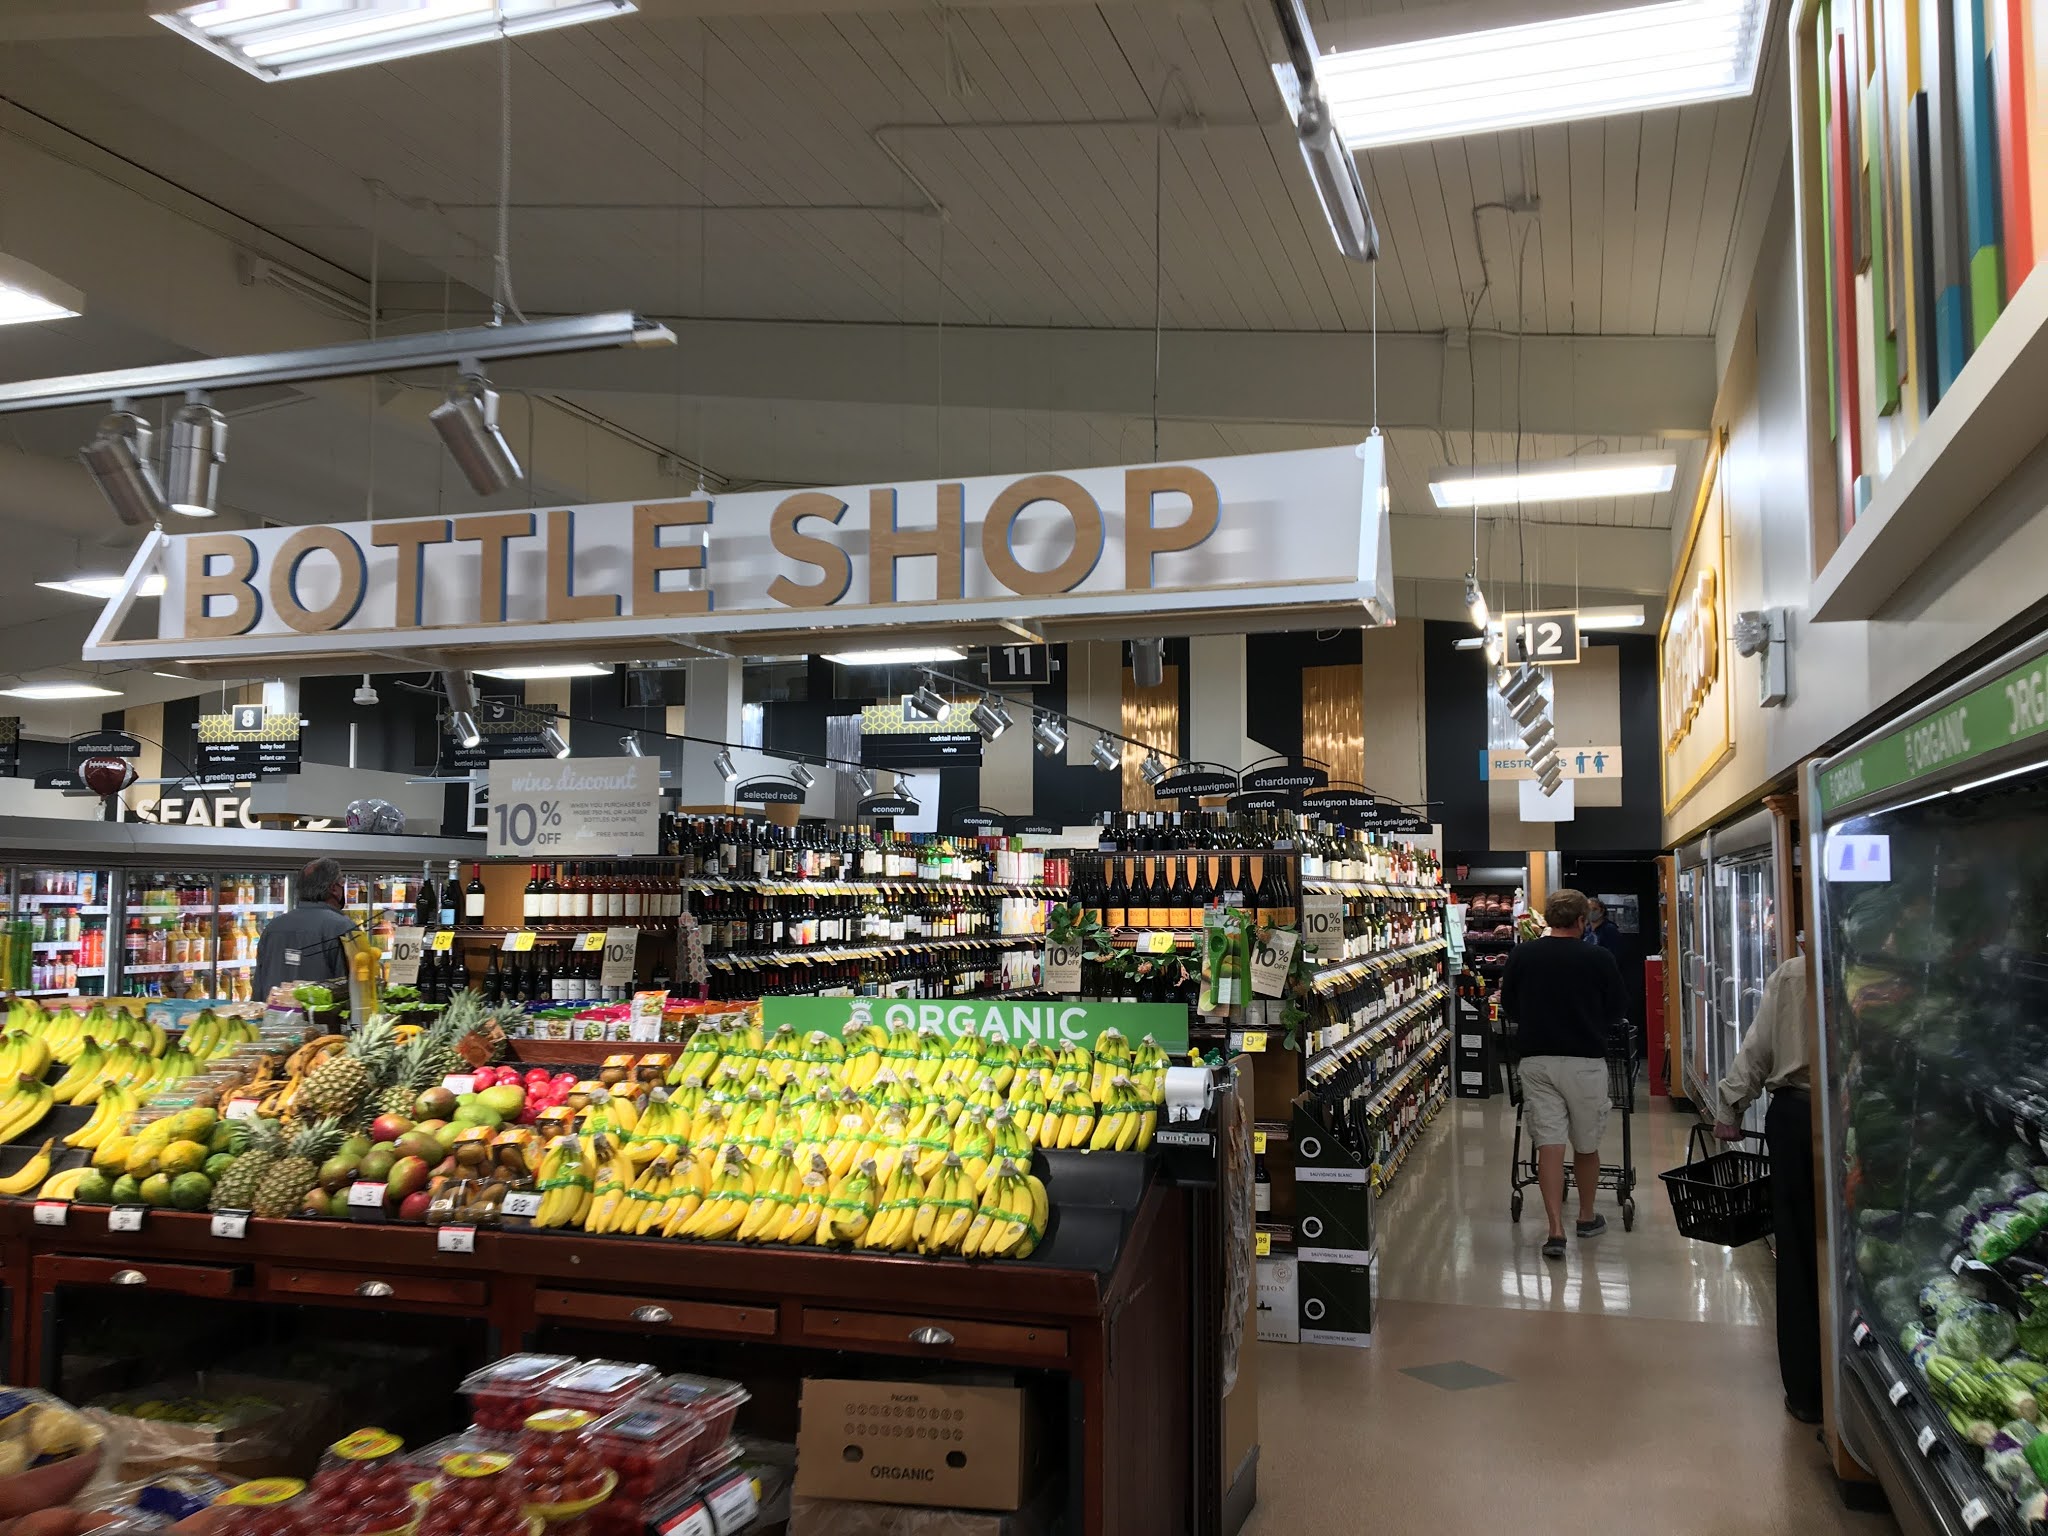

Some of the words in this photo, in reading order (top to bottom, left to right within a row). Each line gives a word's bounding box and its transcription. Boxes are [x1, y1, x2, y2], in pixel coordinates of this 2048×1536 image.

[185, 500, 714, 637] BOTTLE
[766, 466, 1221, 608] SHOP
[1516, 622, 1562, 655] 12
[1003, 647, 1031, 675] 11
[492, 701, 504, 718] 9
[241, 709, 255, 727] 8
[1913, 706, 1971, 769] ORGANIC
[78, 744, 112, 752] enhanced
[114, 744, 134, 752] water
[220, 744, 240, 752] supplies
[1495, 758, 1567, 769] RESTRS
[51, 778, 71, 786] diapers
[205, 774, 235, 782] greeting
[236, 772, 257, 780] cards
[512, 771, 553, 792] wine
[556, 764, 637, 791] discount
[1254, 776, 1315, 787] chardonnay
[1156, 785, 1191, 796] cabernet
[1192, 782, 1235, 793] sauvignon
[744, 790, 777, 800] selected
[779, 791, 798, 800] reds
[1248, 800, 1275, 808] merlot
[1302, 800, 1348, 808] sauvignon
[1349, 798, 1374, 806] blanc
[872, 805, 905, 815] economy
[963, 818, 993, 827] economy
[1384, 818, 1418, 827] gris/grigio
[1025, 825, 1052, 834] sparkling
[537, 833, 562, 845] OFF
[885, 1004, 1088, 1040] ORGANIC
[871, 1466, 935, 1481] ORGANIC
